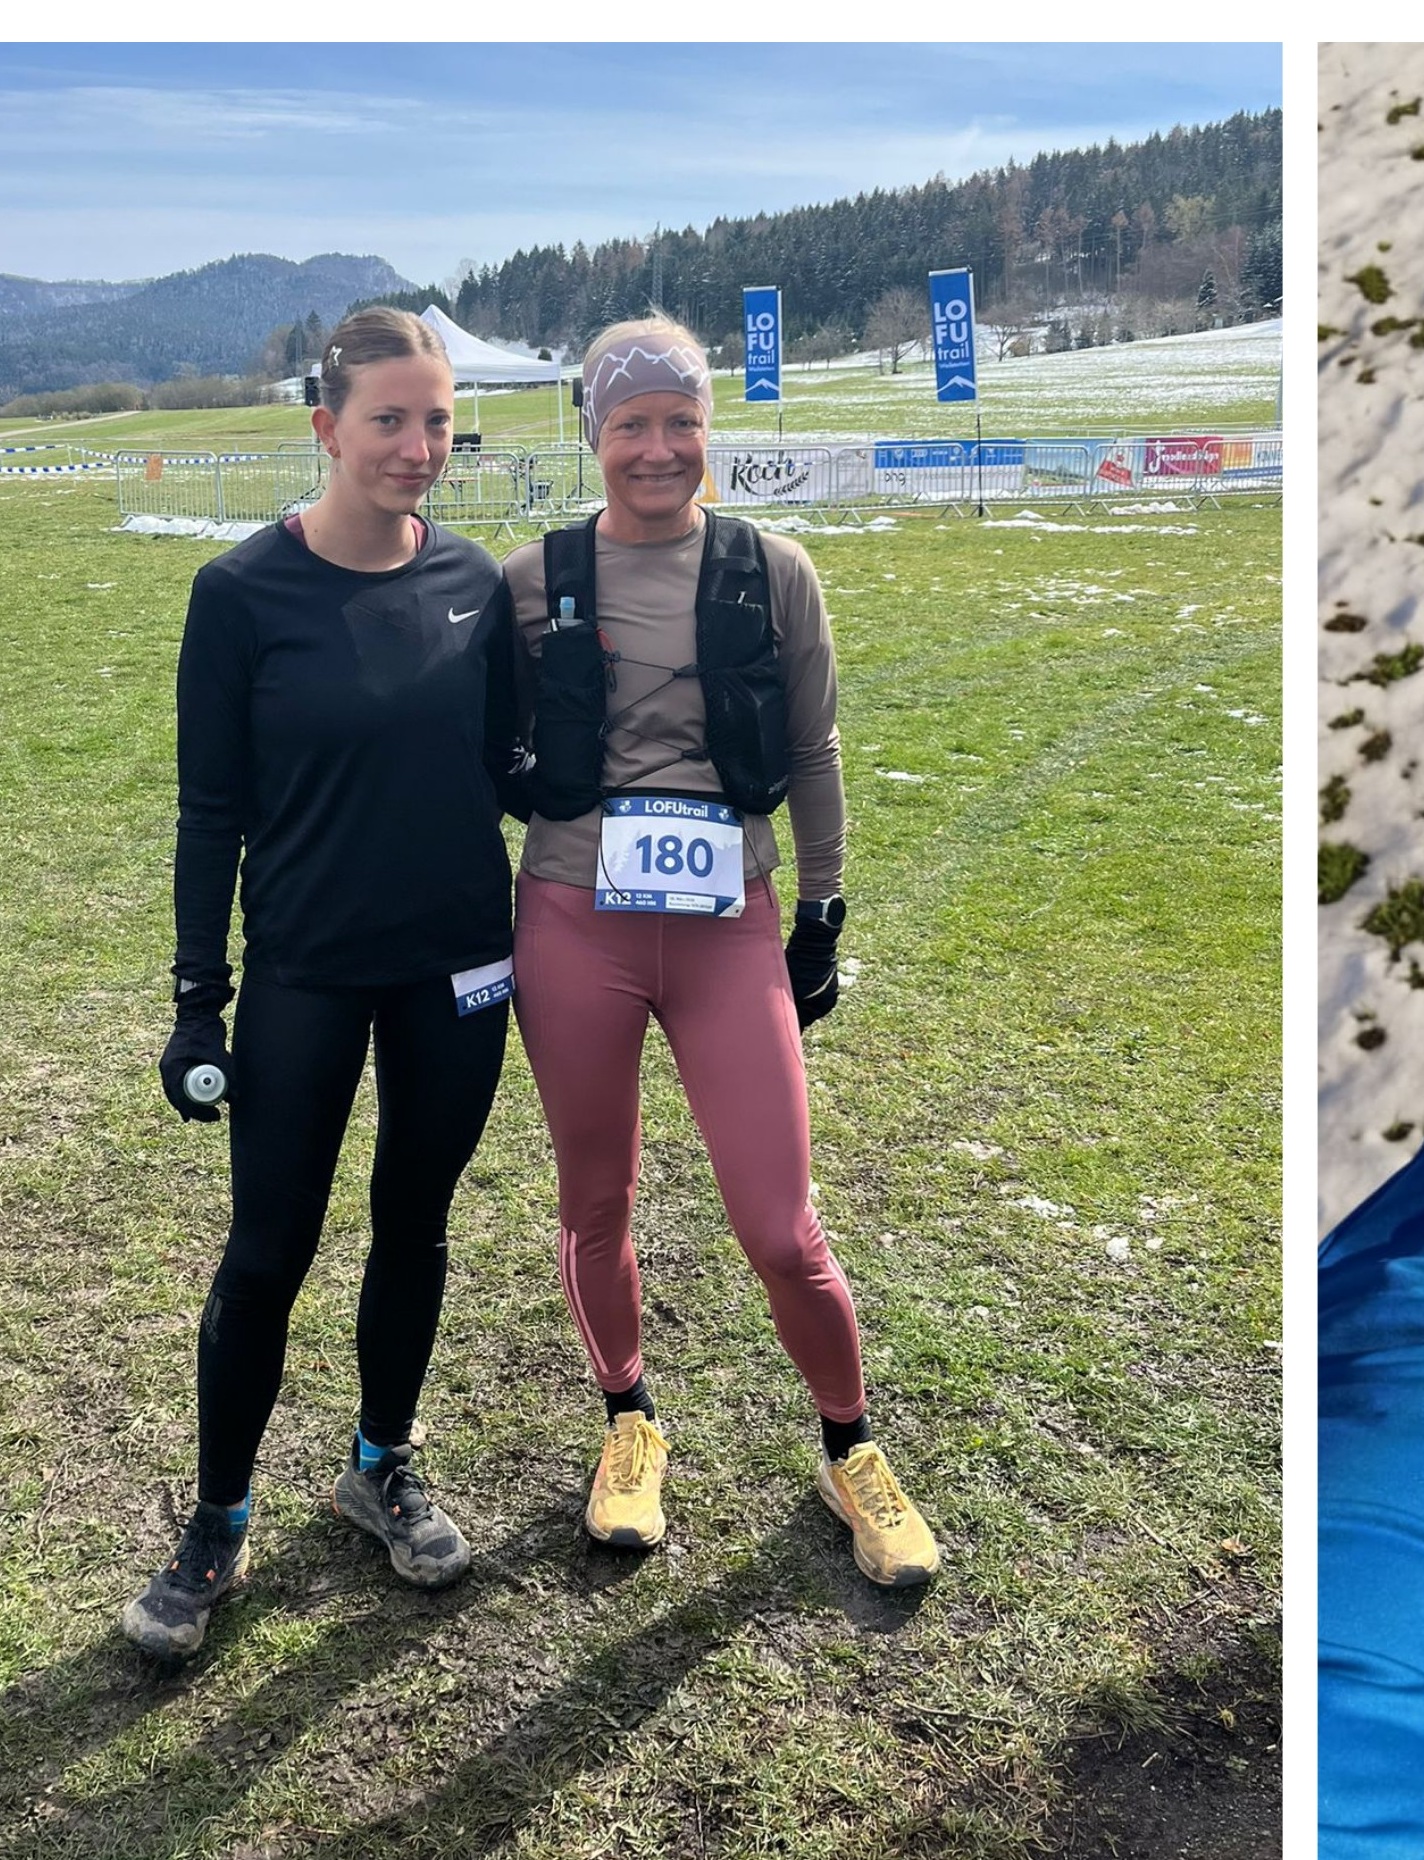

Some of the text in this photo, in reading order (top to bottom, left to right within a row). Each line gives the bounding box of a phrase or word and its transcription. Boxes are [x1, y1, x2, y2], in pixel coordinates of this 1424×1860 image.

[933, 299, 968, 322] LO
[747, 312, 775, 331] LO
[747, 332, 775, 351] FU
[935, 321, 968, 344] FU
[748, 350, 775, 365] trail
[938, 341, 970, 360] trail
[645, 800, 708, 818] LOFUtrail
[636, 834, 714, 878] 180
[605, 891, 631, 906] K12
[466, 989, 491, 1008] K12
